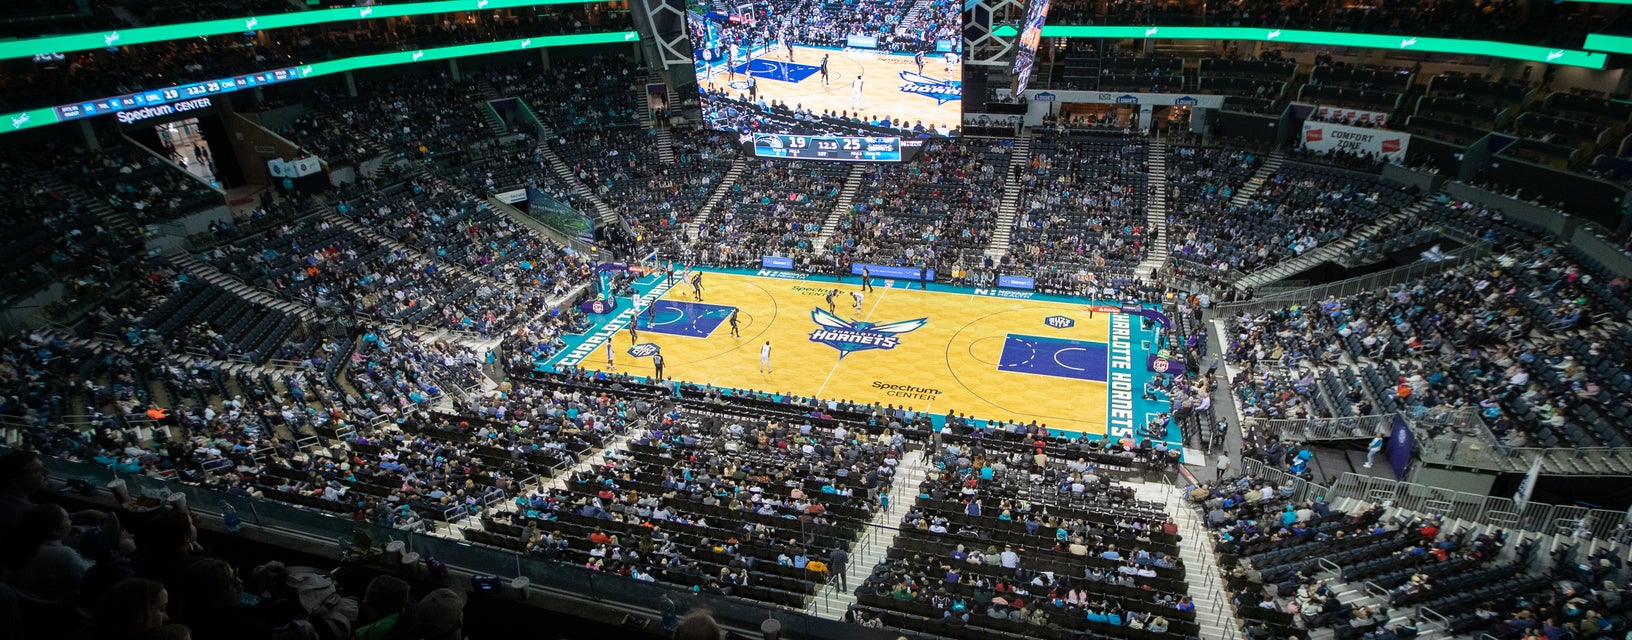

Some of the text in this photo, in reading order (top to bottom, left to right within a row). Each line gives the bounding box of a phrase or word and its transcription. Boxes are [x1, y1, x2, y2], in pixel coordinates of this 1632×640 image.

[164, 89, 179, 99] 19
[207, 82, 220, 92] 25
[117, 98, 211, 124] Spectrum CENTER
[789, 136, 806, 148] 19
[843, 138, 861, 150] 25
[1331, 130, 1374, 143] COMFORT
[818, 141, 838, 150] 12.5
[1337, 140, 1361, 150] ZONE
[561, 308, 638, 366] CHARLOTTE
[811, 330, 896, 348] HORNETS
[1111, 312, 1132, 370] HARLOTTE
[871, 380, 939, 395] Spectrum
[886, 390, 937, 401] CENTER
[1110, 371, 1134, 438] HORNETS
